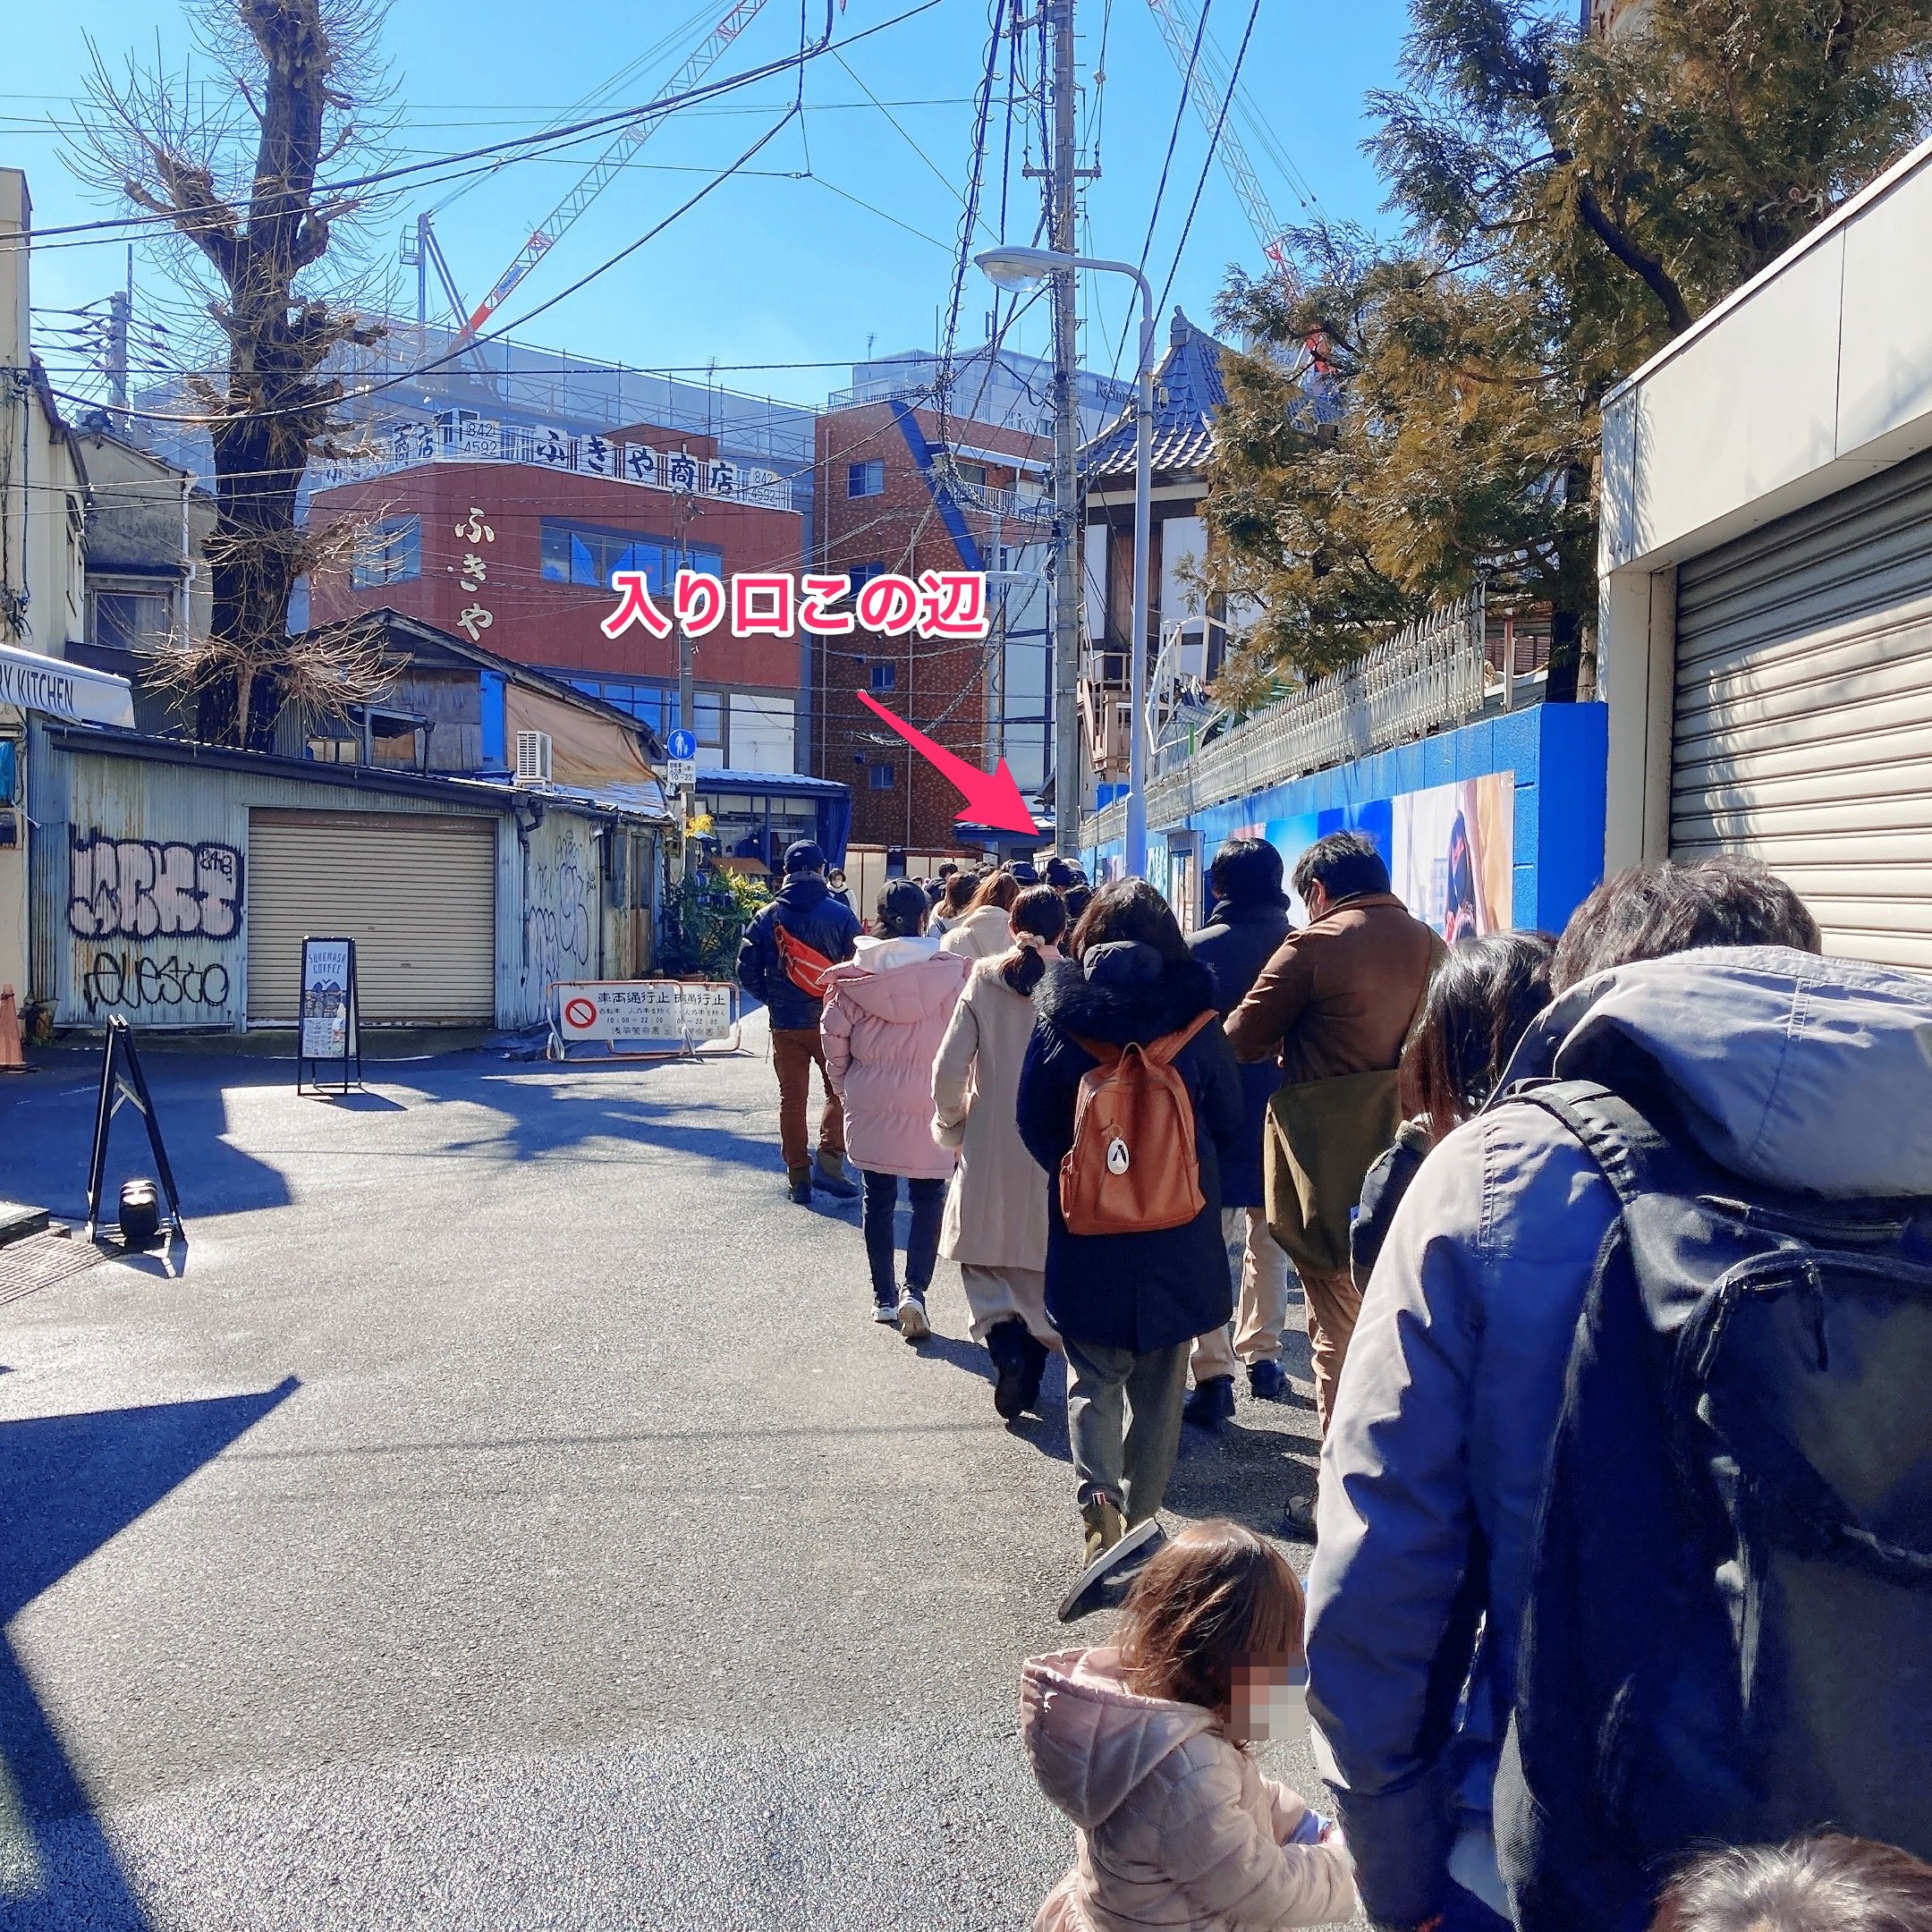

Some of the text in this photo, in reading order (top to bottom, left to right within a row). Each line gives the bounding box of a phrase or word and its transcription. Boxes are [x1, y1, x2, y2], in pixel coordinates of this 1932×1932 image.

[537, 429, 733, 492] ふきや商店
[454, 506, 496, 641] ふきや
[18, 668, 76, 716] KITCHEN
[313, 963, 342, 974] COFFEE
[597, 991, 671, 1004] 車両通行止
